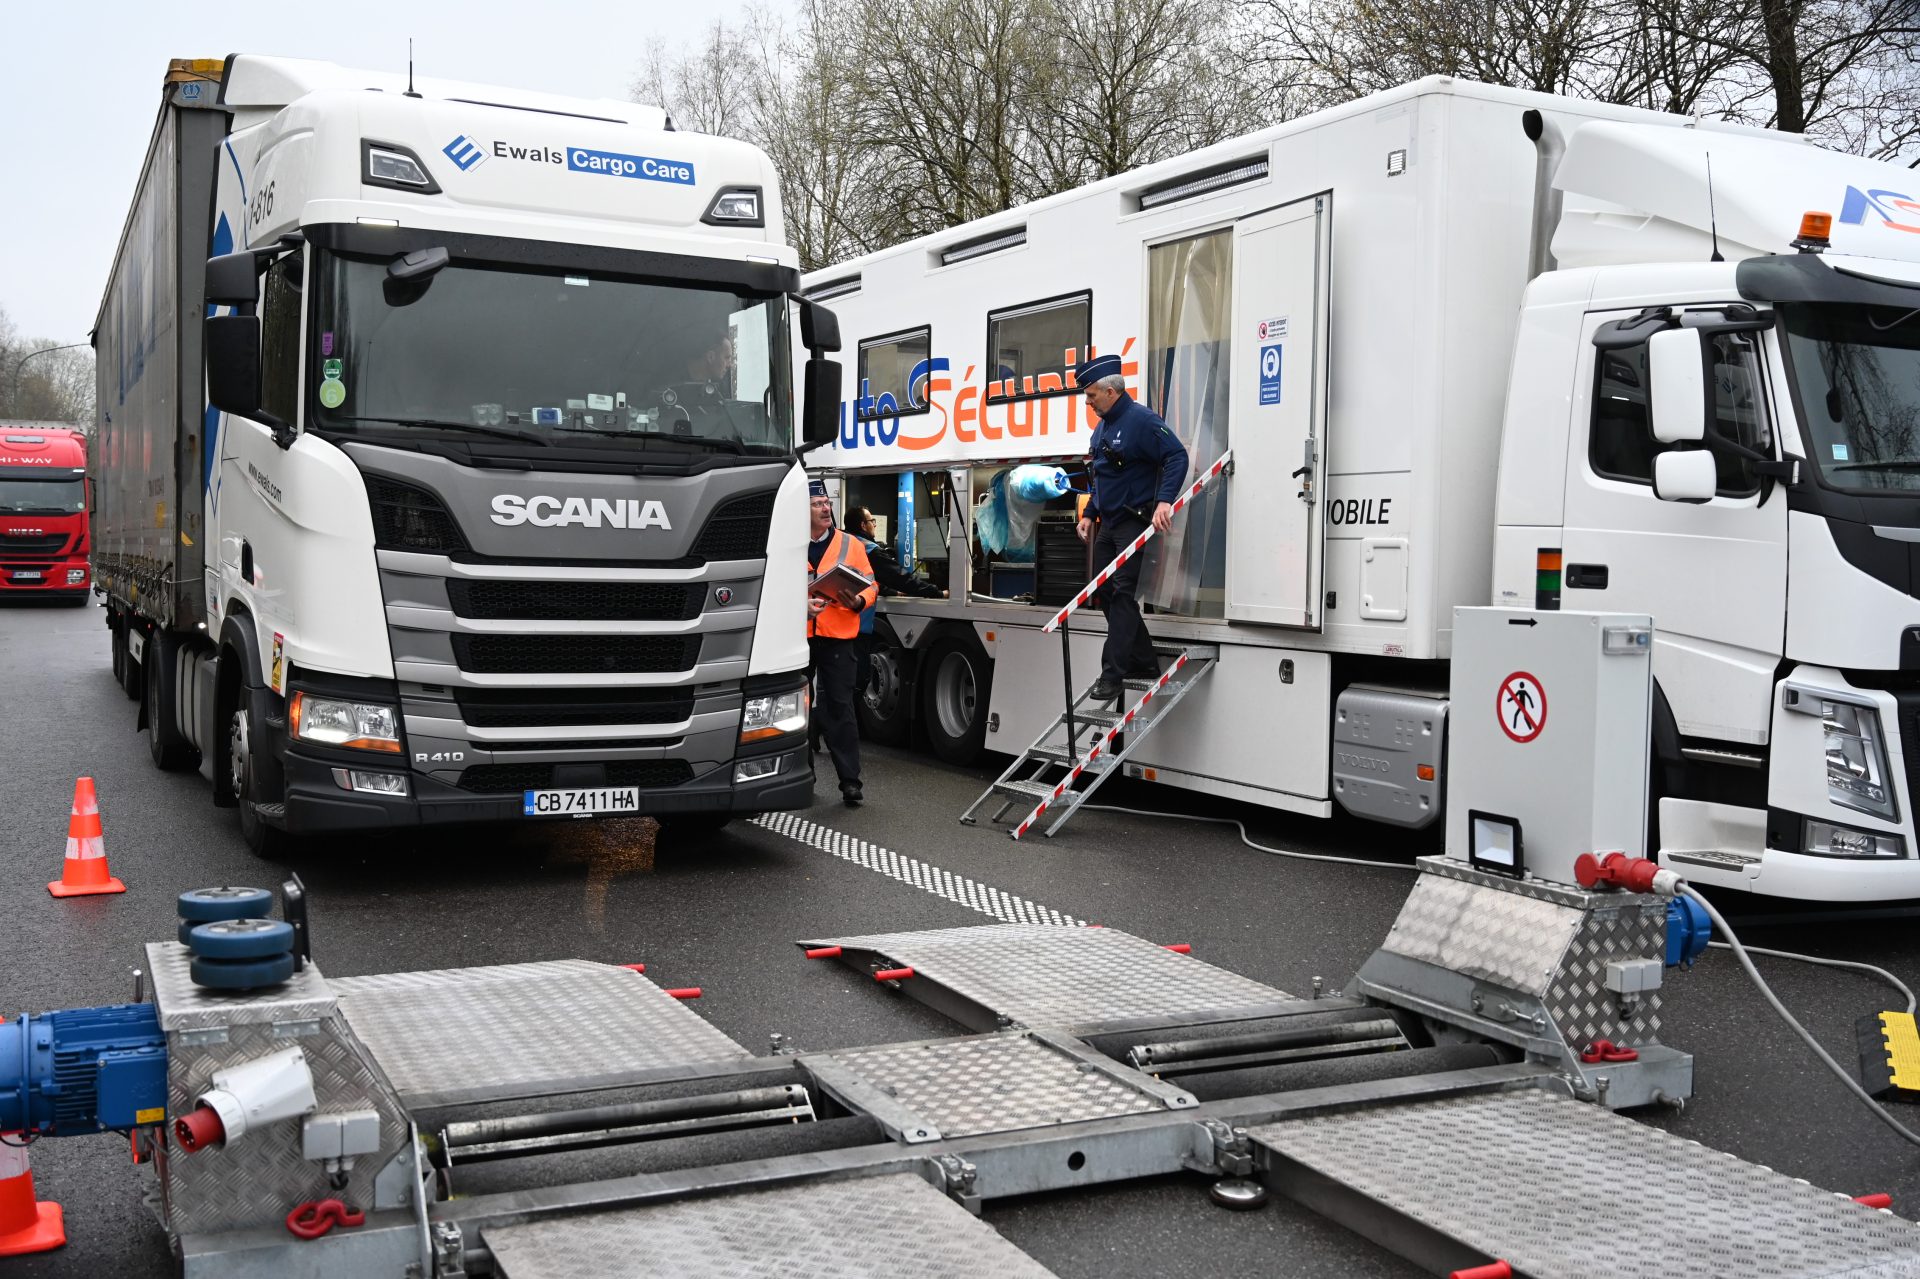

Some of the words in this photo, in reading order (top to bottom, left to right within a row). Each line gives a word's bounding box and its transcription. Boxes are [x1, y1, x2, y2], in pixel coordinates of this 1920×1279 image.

[493, 140, 563, 165] Ewals
[571, 150, 637, 176] Cargo
[641, 159, 690, 181] Care
[490, 494, 673, 531] SCANIA
[1326, 498, 1392, 526] OBILE
[8, 528, 44, 536] IVECO
[416, 753, 429, 763] R
[431, 752, 464, 762] 410
[1337, 752, 1391, 773] VOLVO
[565, 791, 607, 811] 7411
